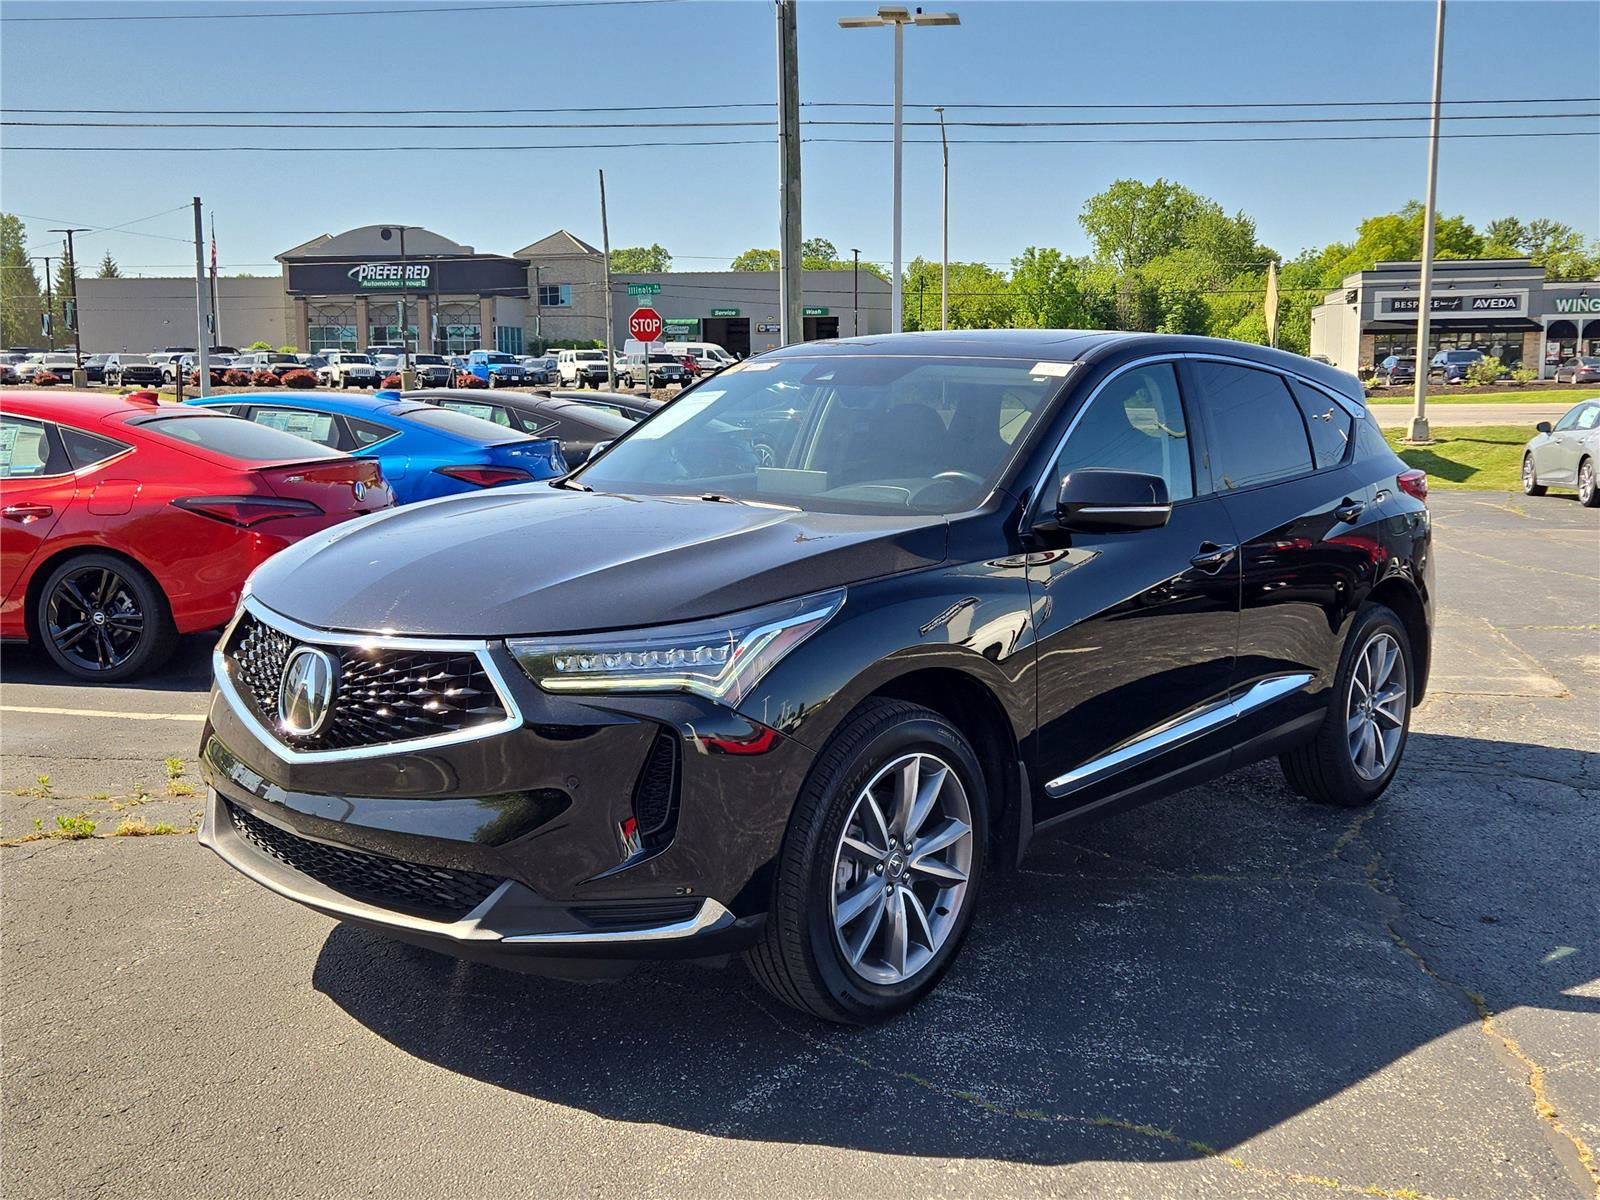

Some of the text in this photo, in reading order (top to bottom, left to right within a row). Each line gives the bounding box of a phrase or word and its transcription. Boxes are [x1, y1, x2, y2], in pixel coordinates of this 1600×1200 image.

[628, 285, 652, 295] Illinois
[1394, 301, 1441, 309] BESPE
[1473, 298, 1516, 308] AVEDA
[1556, 298, 1600, 312] WING
[631, 319, 660, 332] STOP
